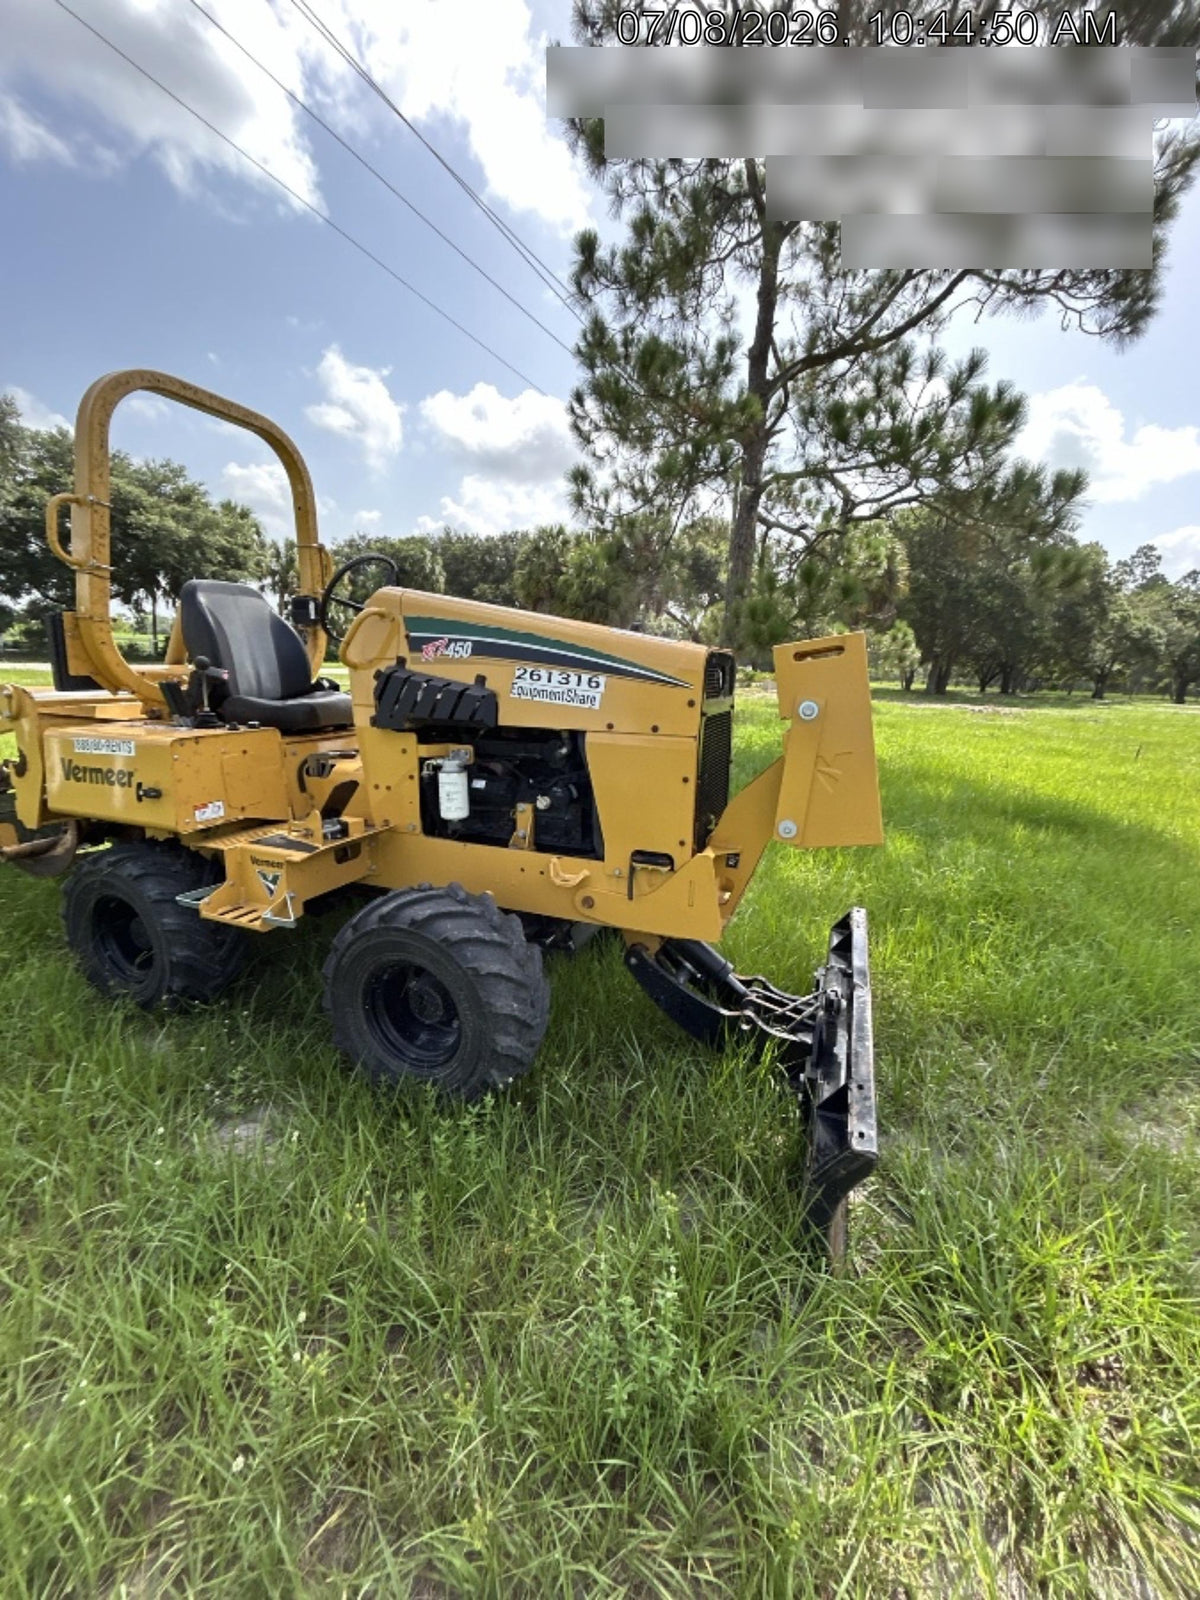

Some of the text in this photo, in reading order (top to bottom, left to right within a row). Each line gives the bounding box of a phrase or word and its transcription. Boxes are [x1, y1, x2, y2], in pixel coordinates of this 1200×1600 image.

[515, 667, 600, 688] 261316
[511, 682, 596, 706] EquipmentShare
[60, 757, 134, 788] Vermeer
